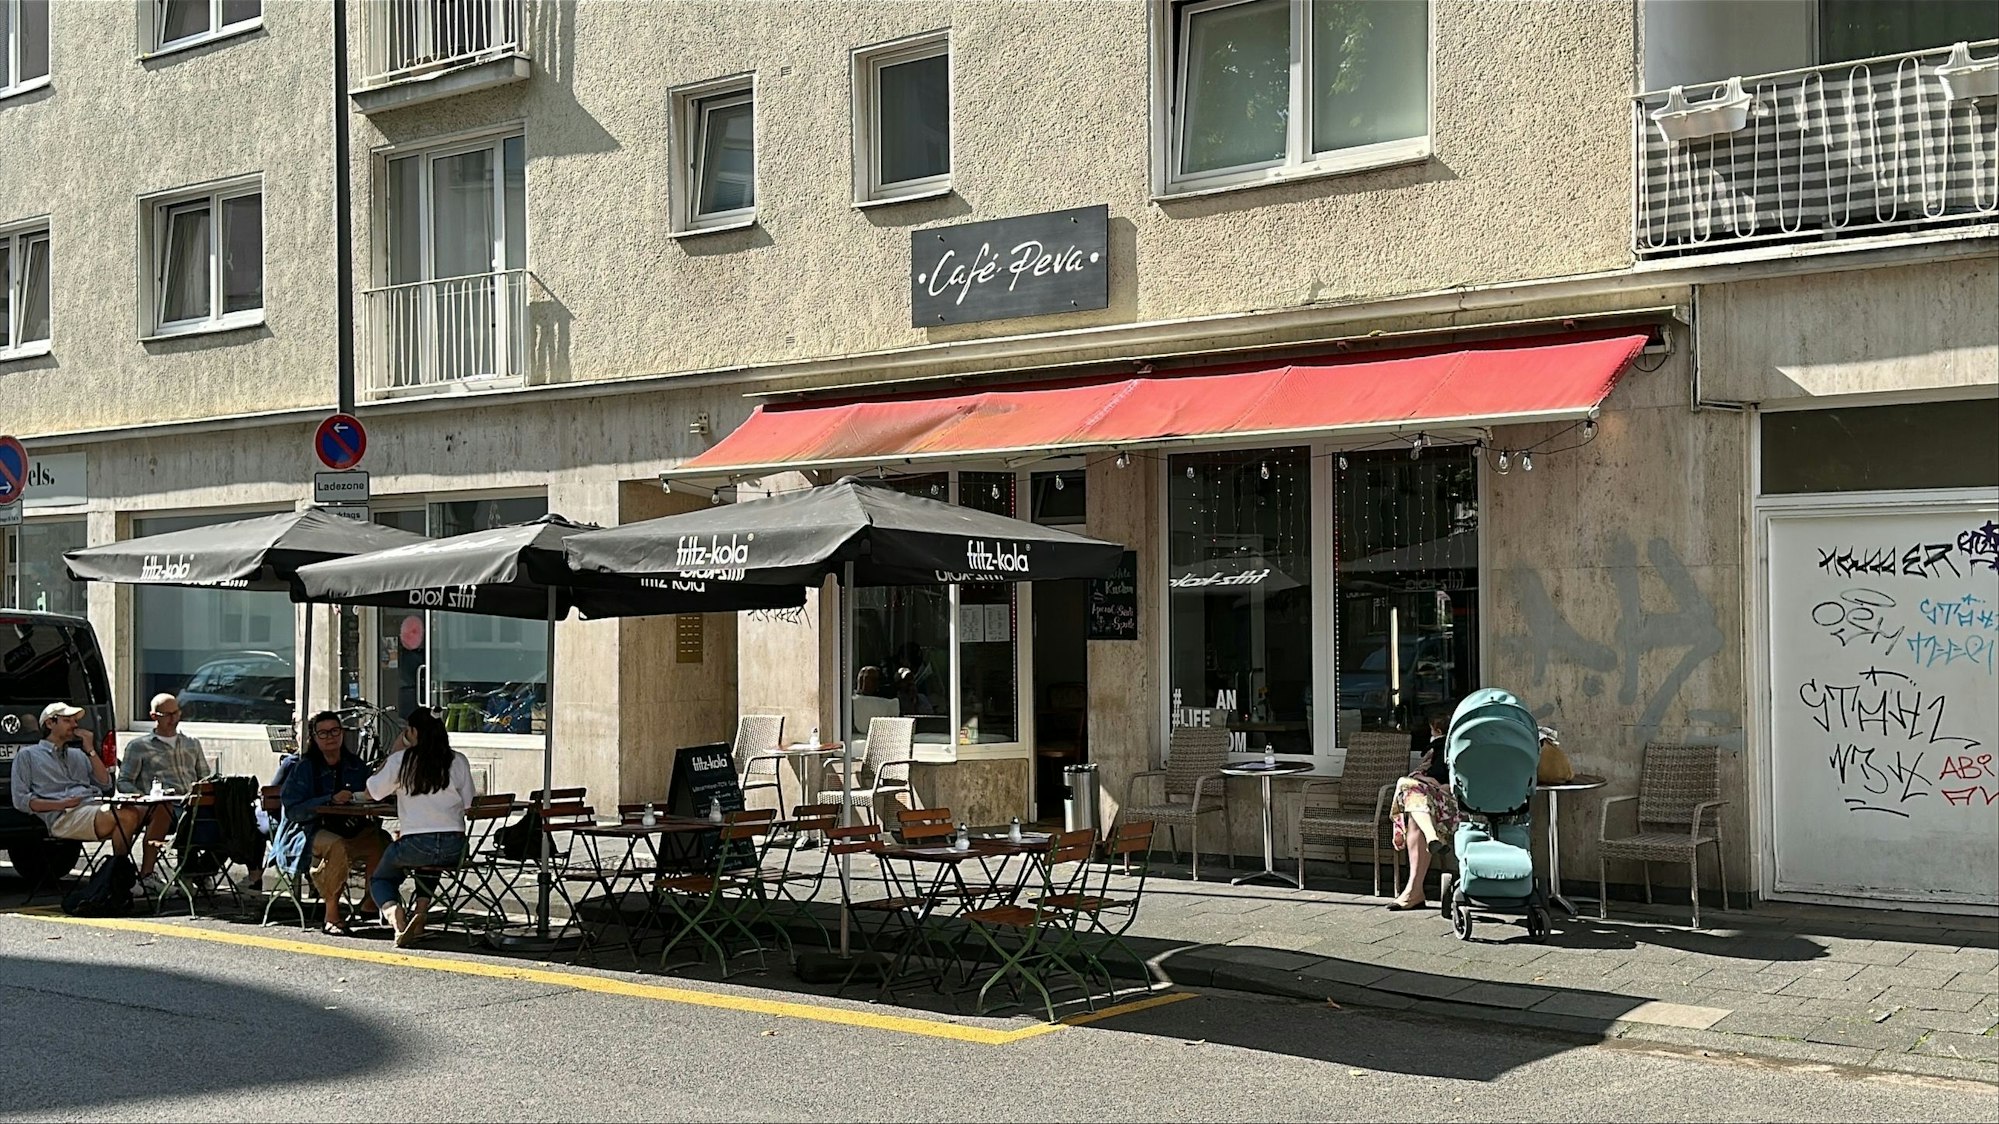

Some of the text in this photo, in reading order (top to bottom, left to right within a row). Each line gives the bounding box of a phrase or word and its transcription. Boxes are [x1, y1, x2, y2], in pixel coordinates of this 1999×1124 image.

[928, 240, 1084, 305] Café Peva
[317, 482, 365, 491] Ladezone
[967, 540, 1029, 572] fritz-kola
[1216, 689, 1237, 710] AN
